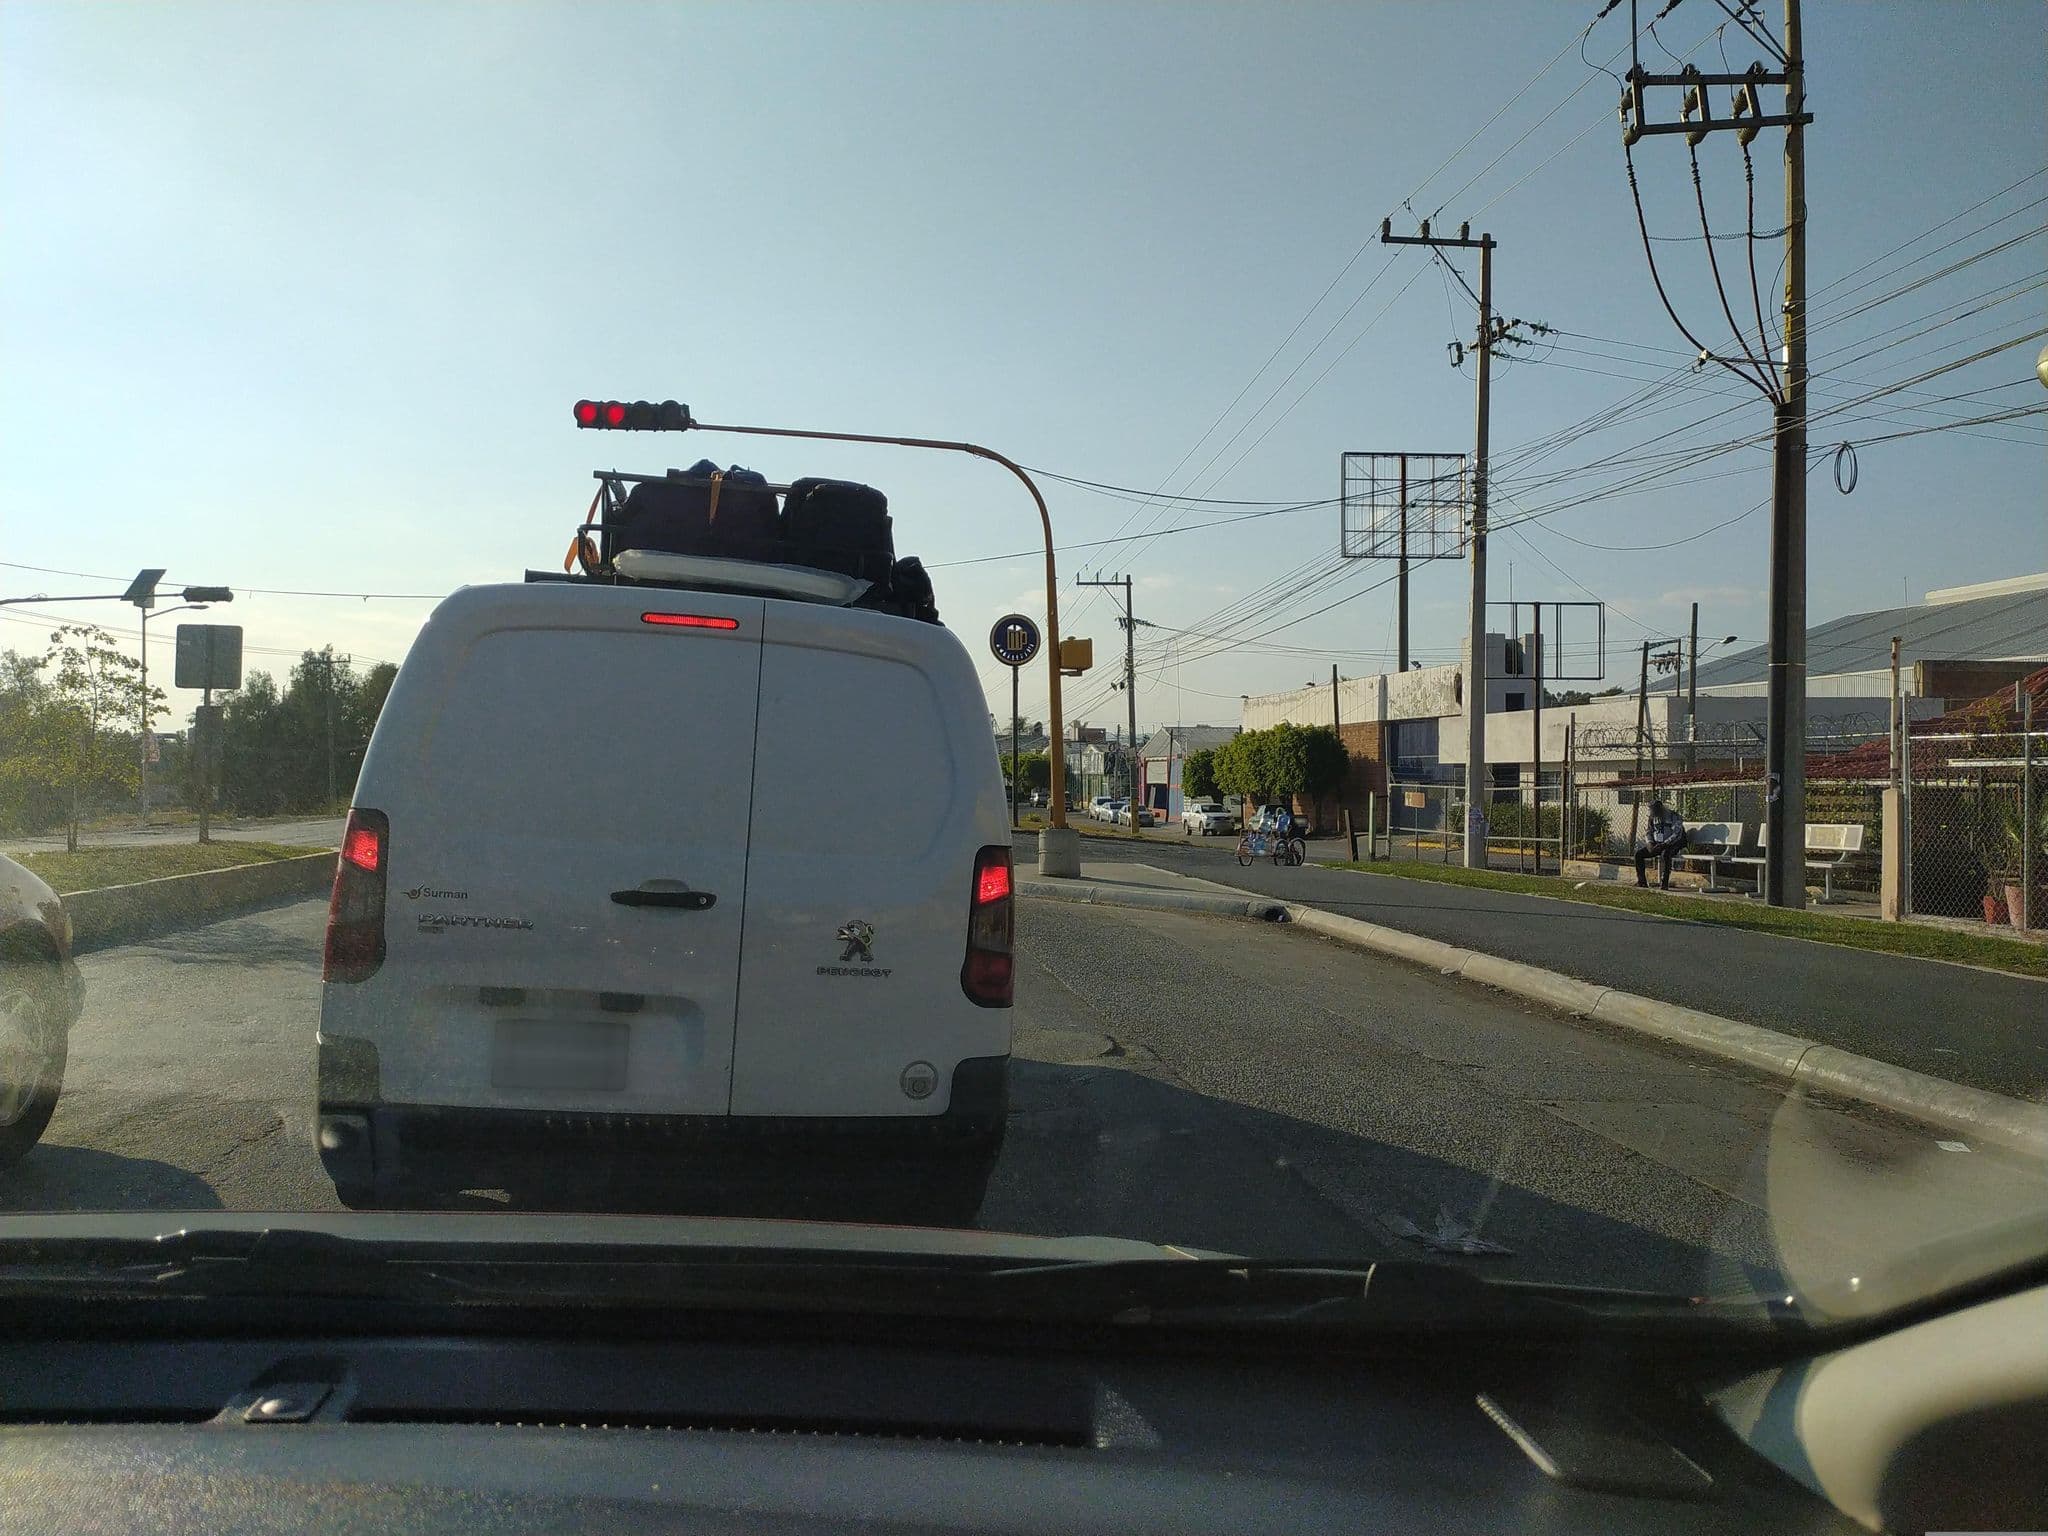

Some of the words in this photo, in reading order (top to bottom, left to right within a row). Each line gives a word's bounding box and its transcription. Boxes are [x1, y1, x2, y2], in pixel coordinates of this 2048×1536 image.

[423, 887, 468, 899] Surman
[418, 912, 535, 930] PARTNER
[816, 966, 892, 977] PEUGEOT
